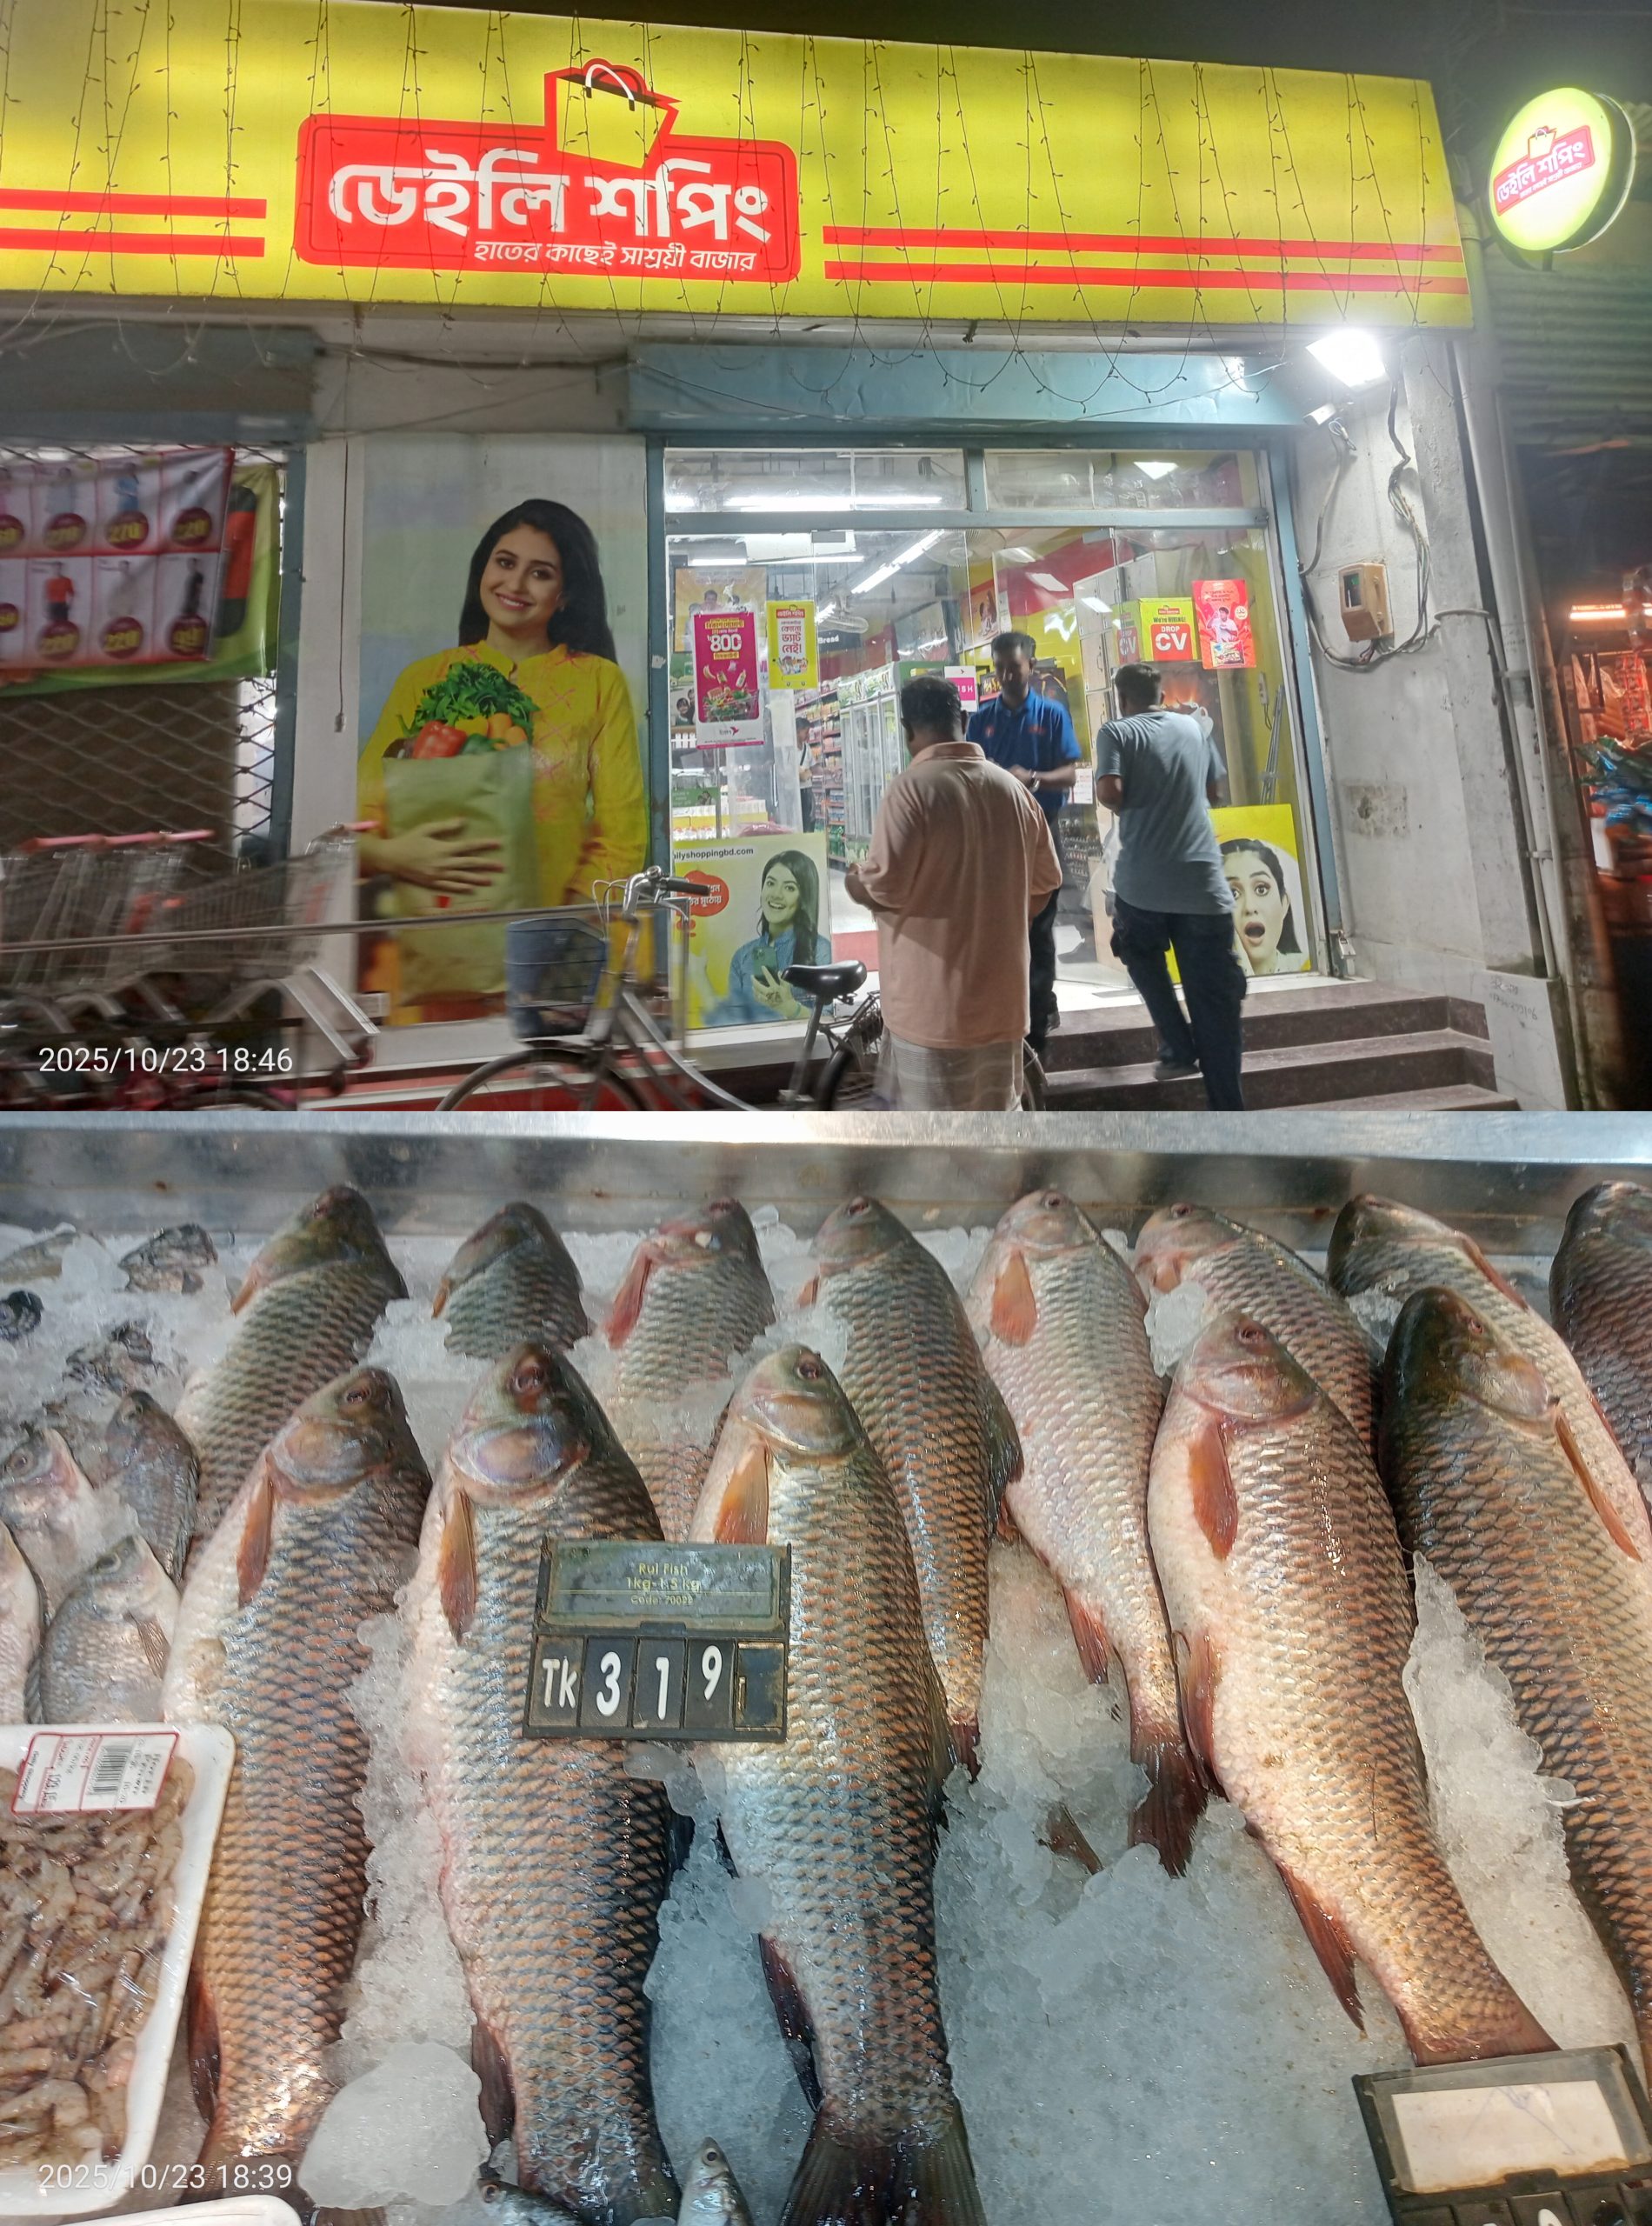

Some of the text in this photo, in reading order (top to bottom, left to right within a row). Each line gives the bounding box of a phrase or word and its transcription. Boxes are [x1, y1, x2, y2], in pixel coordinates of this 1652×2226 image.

[329, 147, 771, 243] ডেইলি শপিং
[1497, 162, 1536, 203] ডেইলি
[474, 241, 543, 262] হাতের
[545, 241, 617, 266] কাছেই
[689, 250, 757, 272] বাজার
[1155, 633, 1188, 651] CV
